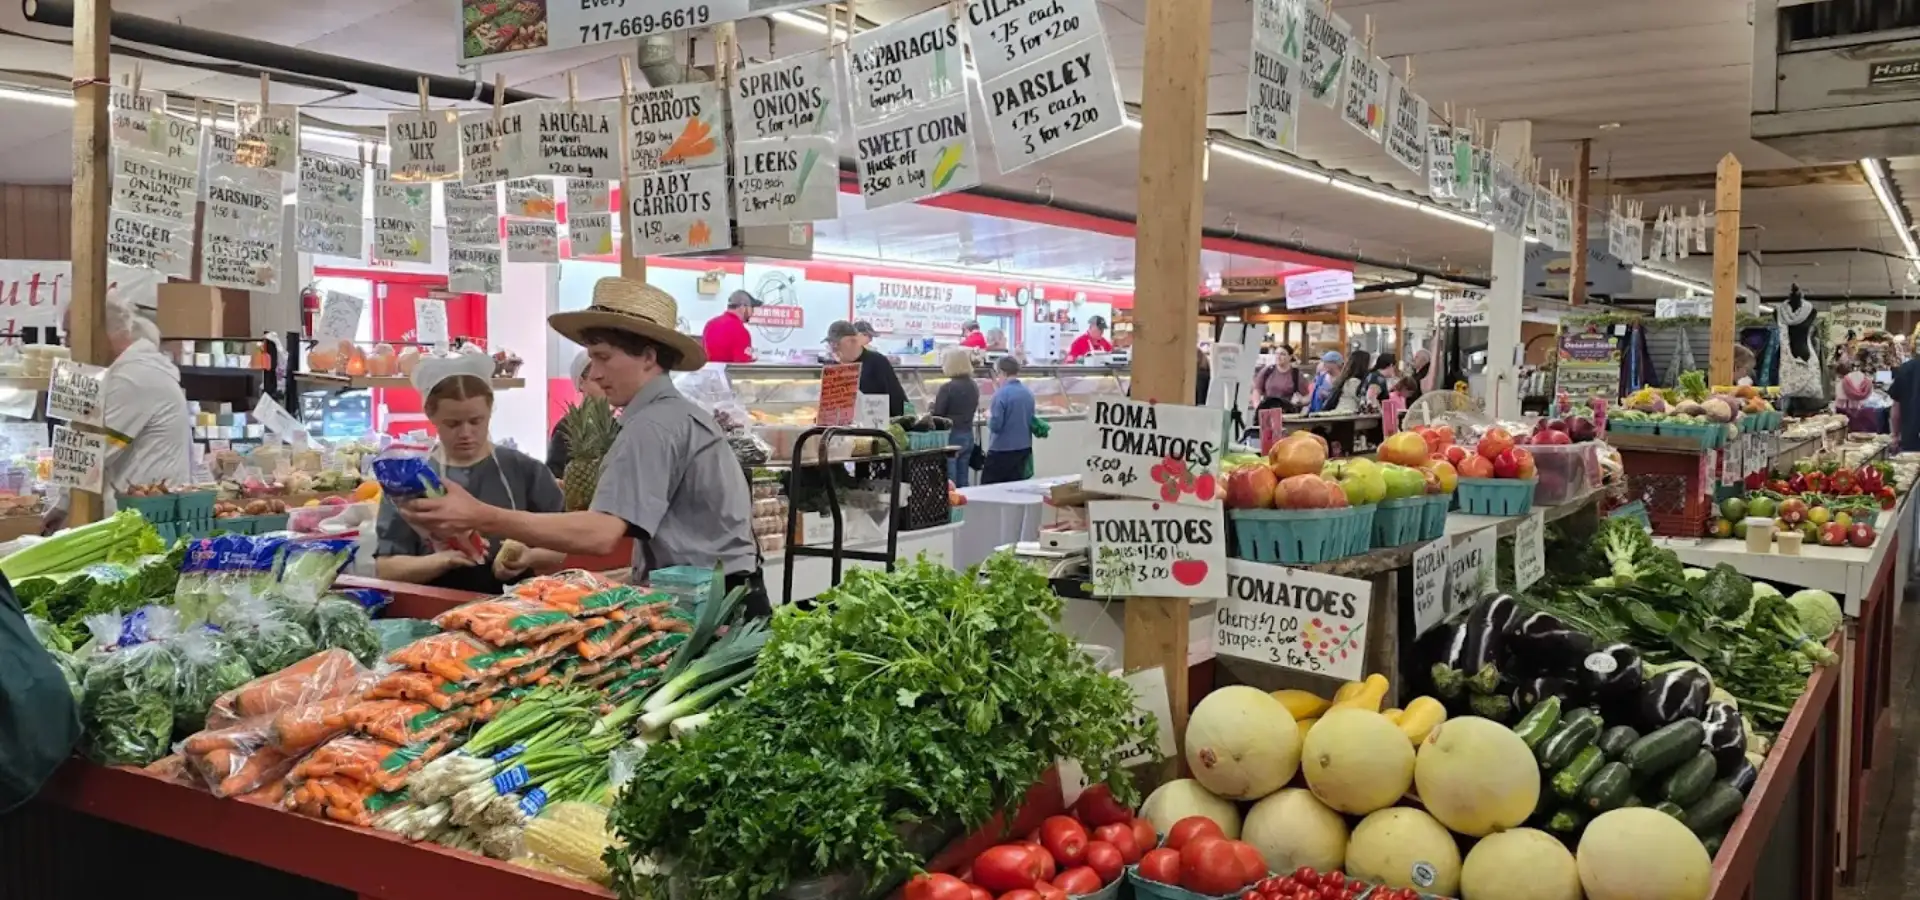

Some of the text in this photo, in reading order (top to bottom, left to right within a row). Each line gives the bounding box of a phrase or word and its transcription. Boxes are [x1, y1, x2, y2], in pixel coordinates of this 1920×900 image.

[579, 5, 709, 43] 717-669-6619
[1028, 0, 1065, 25] each
[852, 24, 957, 74] ASPARAGUS
[1005, 44, 1016, 61] 3
[1020, 34, 1042, 54] for
[739, 65, 804, 98] SPRING
[1254, 50, 1289, 88] YELLOW
[870, 83, 914, 108] bunch
[992, 52, 1091, 117] PARSLEY
[113, 93, 152, 113] CELERY
[631, 95, 701, 126] CARROTS
[753, 86, 822, 119] ONIONS
[1048, 89, 1087, 115] each
[1260, 82, 1292, 118] SQUASH
[397, 121, 437, 141] SALAD
[463, 114, 522, 143] SPINACH
[539, 113, 609, 134] ARUGALA
[756, 119, 765, 137] 5
[768, 117, 784, 134] for
[858, 111, 968, 160] SWEET CORN
[409, 142, 435, 160] MIX
[1022, 134, 1036, 154] 3
[1039, 123, 1061, 144] for
[539, 144, 608, 160] HOMEGROWN
[744, 150, 797, 176] LEEKS
[578, 163, 593, 178] bag
[897, 175, 904, 186] a
[907, 168, 926, 189] bag
[129, 177, 181, 199] ONIONS
[643, 173, 692, 198] BABY
[764, 177, 784, 190] each
[633, 191, 711, 217] CARROTS
[742, 197, 752, 212] 2
[753, 195, 769, 211] for
[115, 217, 171, 244] GINGER
[374, 217, 416, 233] LEMONS
[879, 281, 954, 302] HUMMER'S
[1438, 312, 1485, 324] PRODUCE
[1095, 401, 1158, 430] ROMA
[56, 427, 85, 449] SWEET
[1099, 426, 1214, 467] TOMATOES
[53, 443, 97, 468] POTATOES
[1101, 472, 1114, 485] a
[1092, 518, 1213, 545] TOMATOES
[1452, 547, 1483, 579] FENNEL
[1227, 573, 1357, 620] TOMATOES
[1217, 630, 1298, 650] grape: a box
[1268, 647, 1281, 664] 3
[1285, 649, 1306, 667] for
